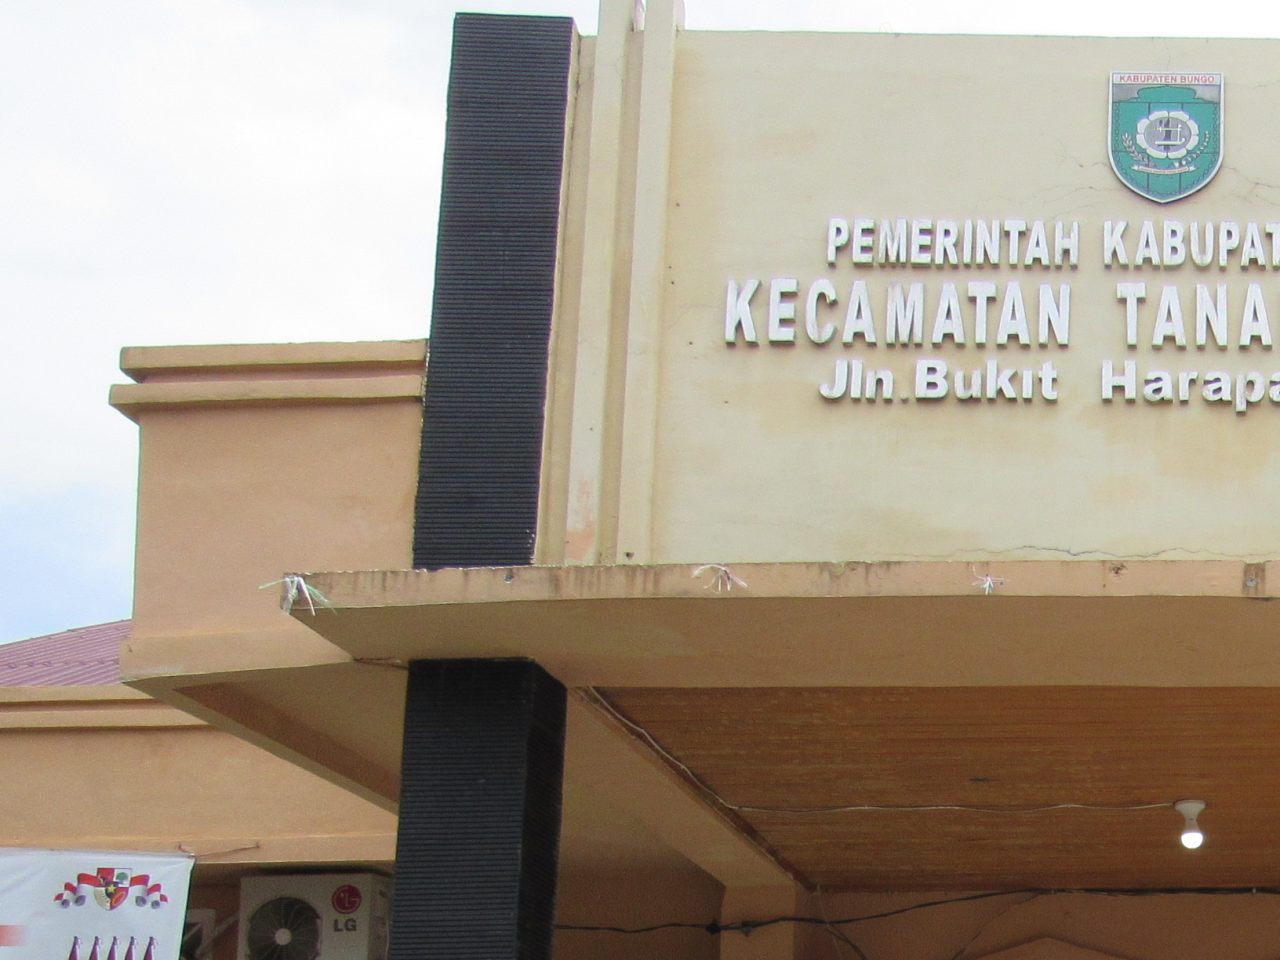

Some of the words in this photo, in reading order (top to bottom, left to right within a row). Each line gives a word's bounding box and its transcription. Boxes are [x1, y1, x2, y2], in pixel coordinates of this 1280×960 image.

[1119, 75, 1177, 83] KABUPATEN
[1179, 76, 1215, 84] BUNGO
[827, 218, 1079, 269] PEMERINTAH
[725, 278, 1071, 347] KECAMATAN
[334, 918, 357, 932] LG
